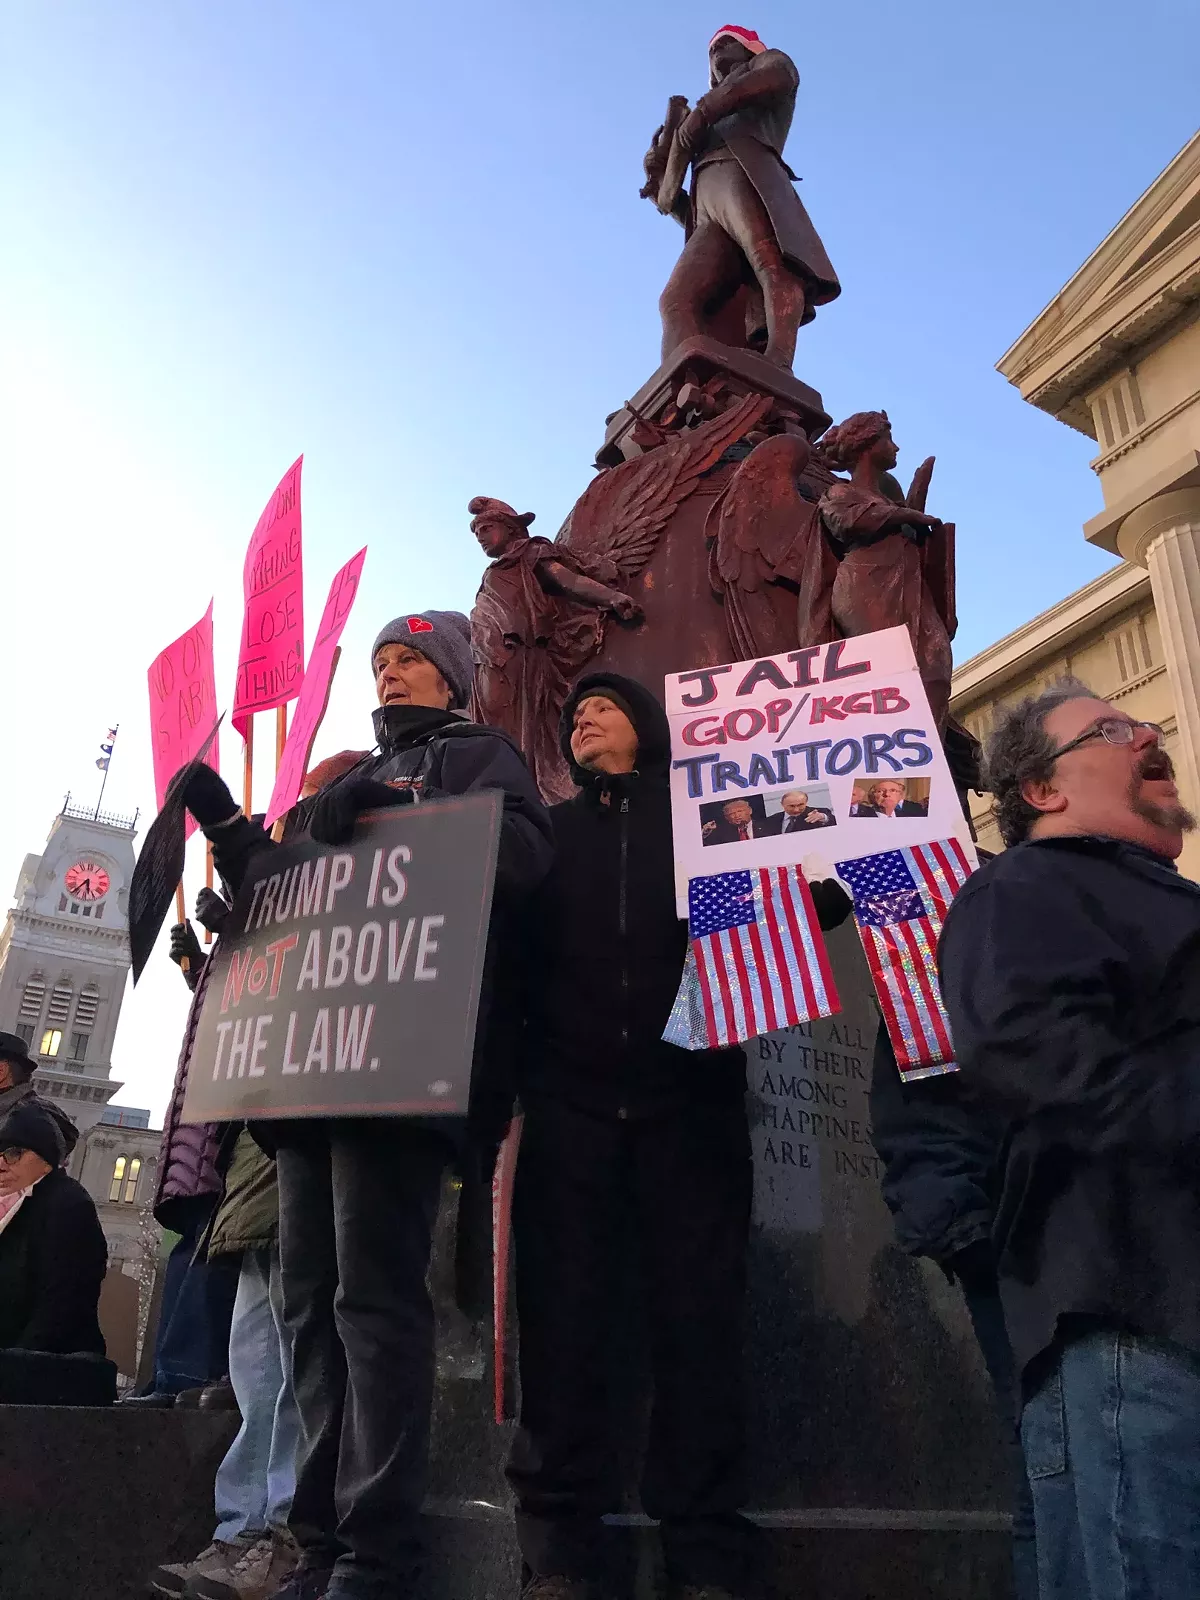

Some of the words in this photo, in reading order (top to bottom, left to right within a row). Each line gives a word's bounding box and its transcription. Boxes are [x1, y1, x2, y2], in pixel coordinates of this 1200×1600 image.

[247, 591, 297, 648] LOSE
[677, 640, 871, 707] JAIL
[681, 687, 910, 746] GOP/KGB
[672, 728, 933, 799] TRAITORS
[244, 853, 355, 933] TRUMP
[366, 844, 412, 909] IS
[220, 931, 299, 1015] NOT
[297, 914, 445, 992] ABOVE
[212, 1014, 273, 1082] THE
[282, 1003, 380, 1075] LAW.
[759, 1036, 787, 1064] BY
[798, 1045, 867, 1081] THEIR
[827, 1023, 869, 1051] ALL
[760, 1071, 848, 1108] AMONG
[764, 1137, 812, 1169] ARE
